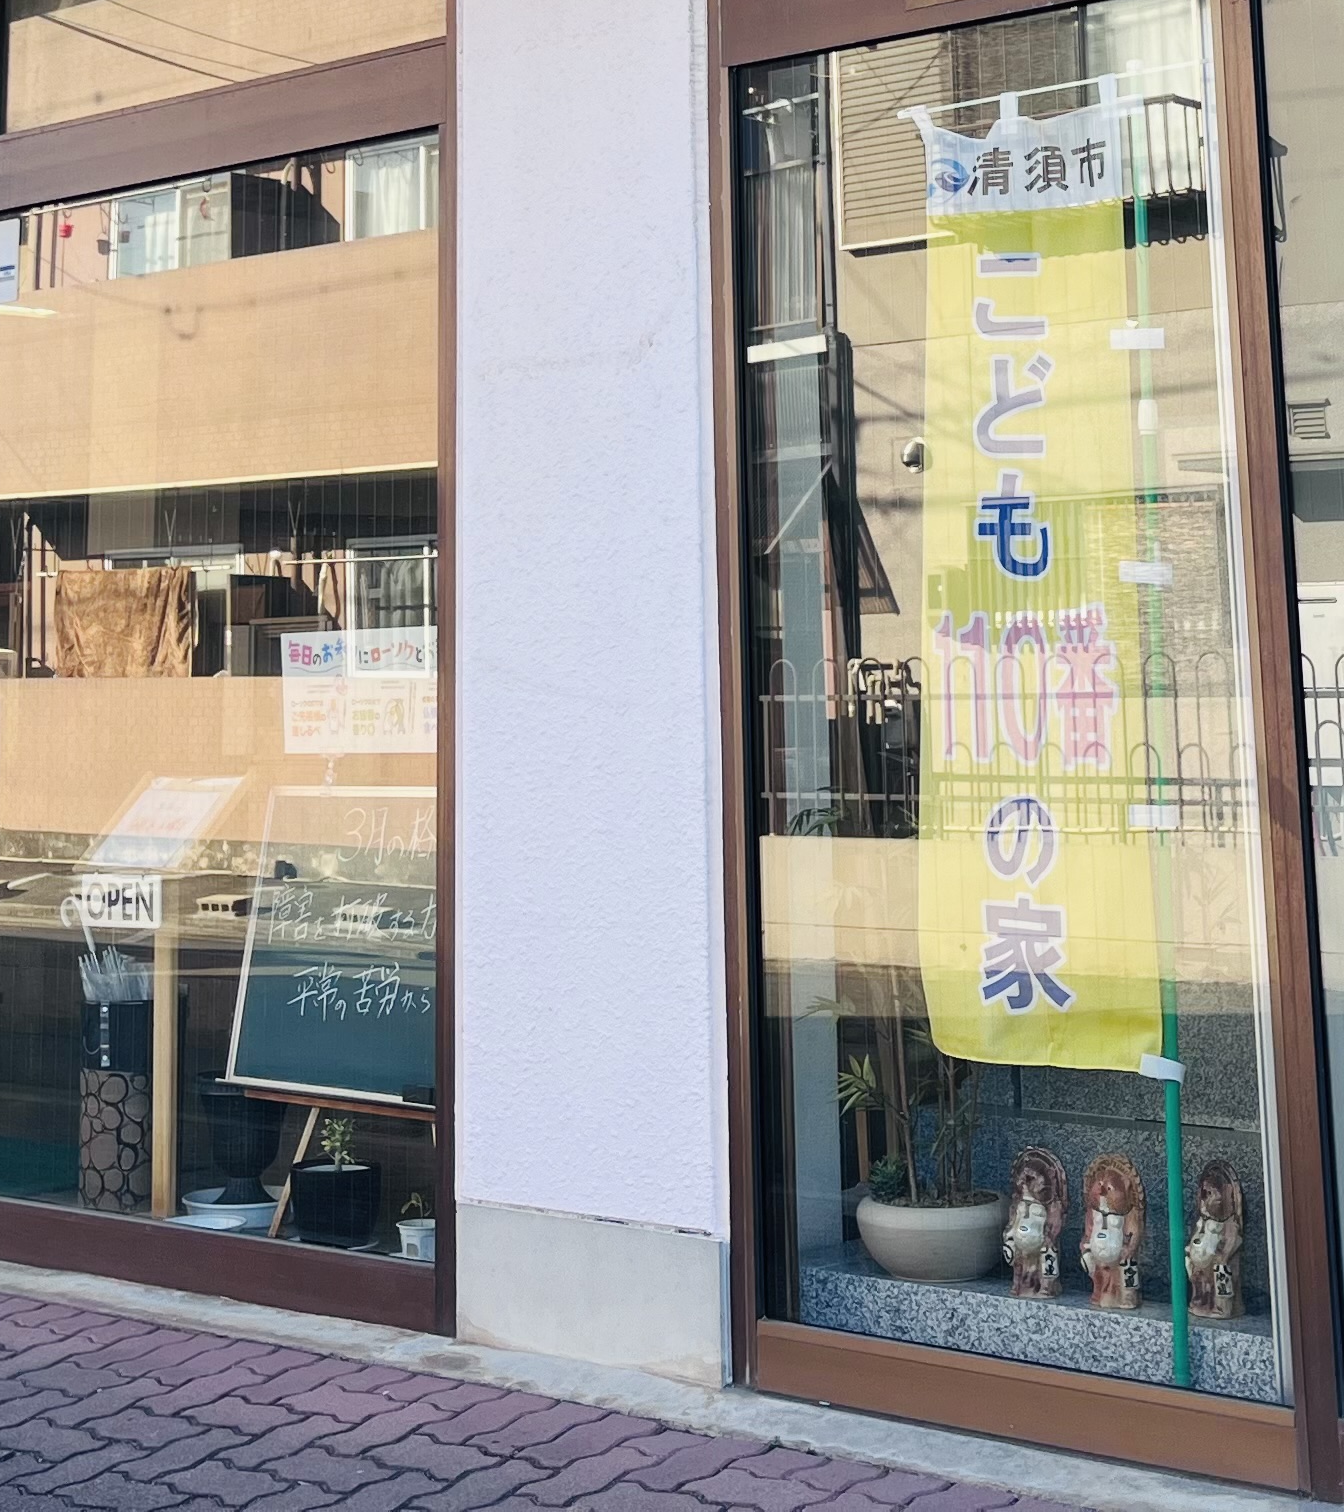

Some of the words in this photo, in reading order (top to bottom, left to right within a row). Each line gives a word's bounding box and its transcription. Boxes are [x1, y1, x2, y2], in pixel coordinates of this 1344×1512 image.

[967, 138, 1107, 197] 清須市
[933, 254, 1119, 1014] こども110番の家
[86, 875, 155, 922] OPEN
[287, 961, 431, 1022] 平常の苦労から
